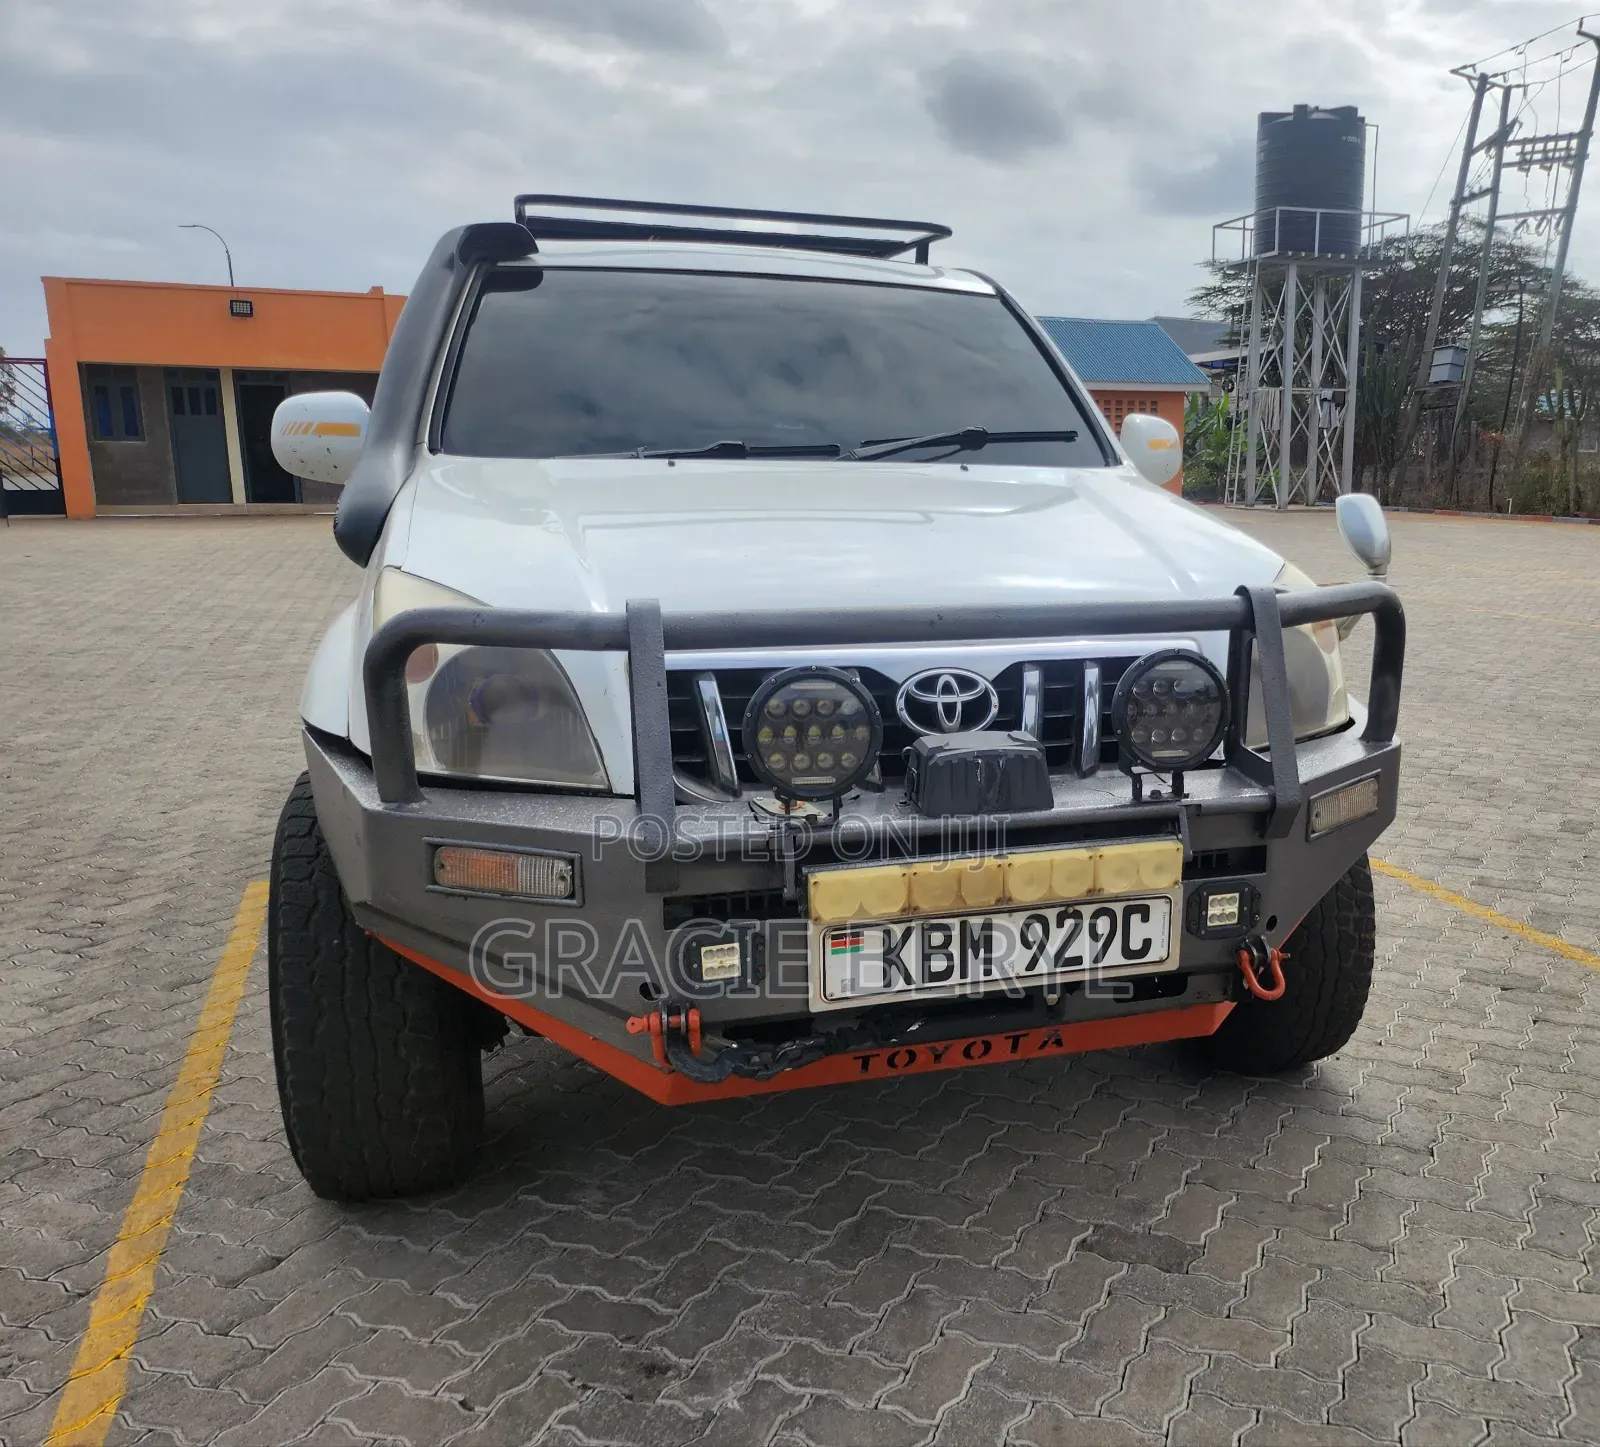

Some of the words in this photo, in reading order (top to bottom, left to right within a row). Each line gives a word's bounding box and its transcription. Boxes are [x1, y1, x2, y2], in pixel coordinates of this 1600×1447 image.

[882, 917, 993, 988] KBM
[1019, 903, 1152, 972] 929C
[854, 1030, 1064, 1073] TOYOTA
